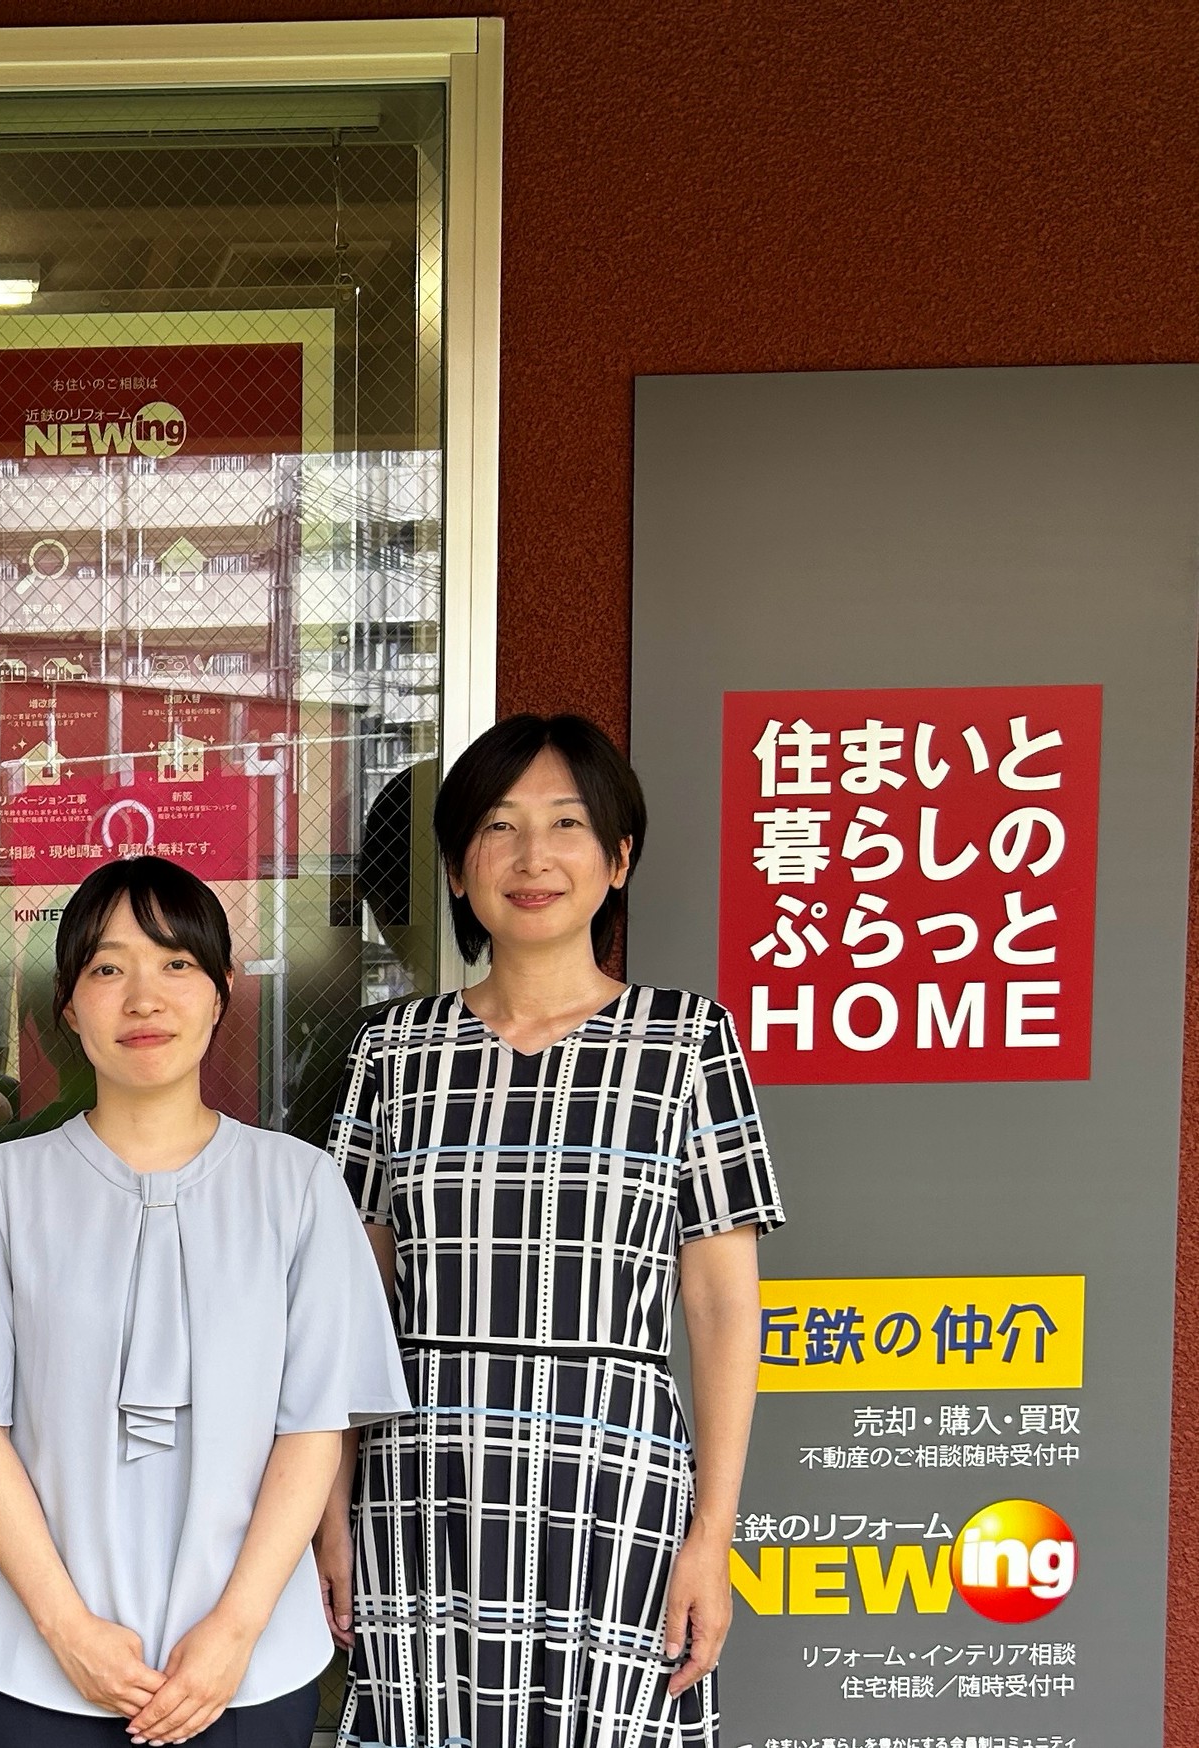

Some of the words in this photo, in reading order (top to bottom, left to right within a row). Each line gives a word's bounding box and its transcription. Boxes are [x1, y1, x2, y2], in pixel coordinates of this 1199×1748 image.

[53, 377, 158, 392] お住いのご相談は
[25, 408, 132, 423] 近鉄のリフォーム
[752, 715, 1063, 798] 住まいと
[0, 794, 88, 806] リノベーション工事
[752, 805, 1065, 884] 暮らしの
[750, 891, 1057, 969] ぷらっと
[750, 981, 1061, 1052] HOME
[760, 1303, 1058, 1367] 近鉄の仲介
[853, 1404, 1081, 1438] 売却・購入・買取
[799, 1443, 1080, 1470] 不動産のご相談随時受付中
[802, 1642, 1076, 1668] リフォーム・インテリア相談
[840, 1673, 1075, 1699] 住宅相談／随時受付中
